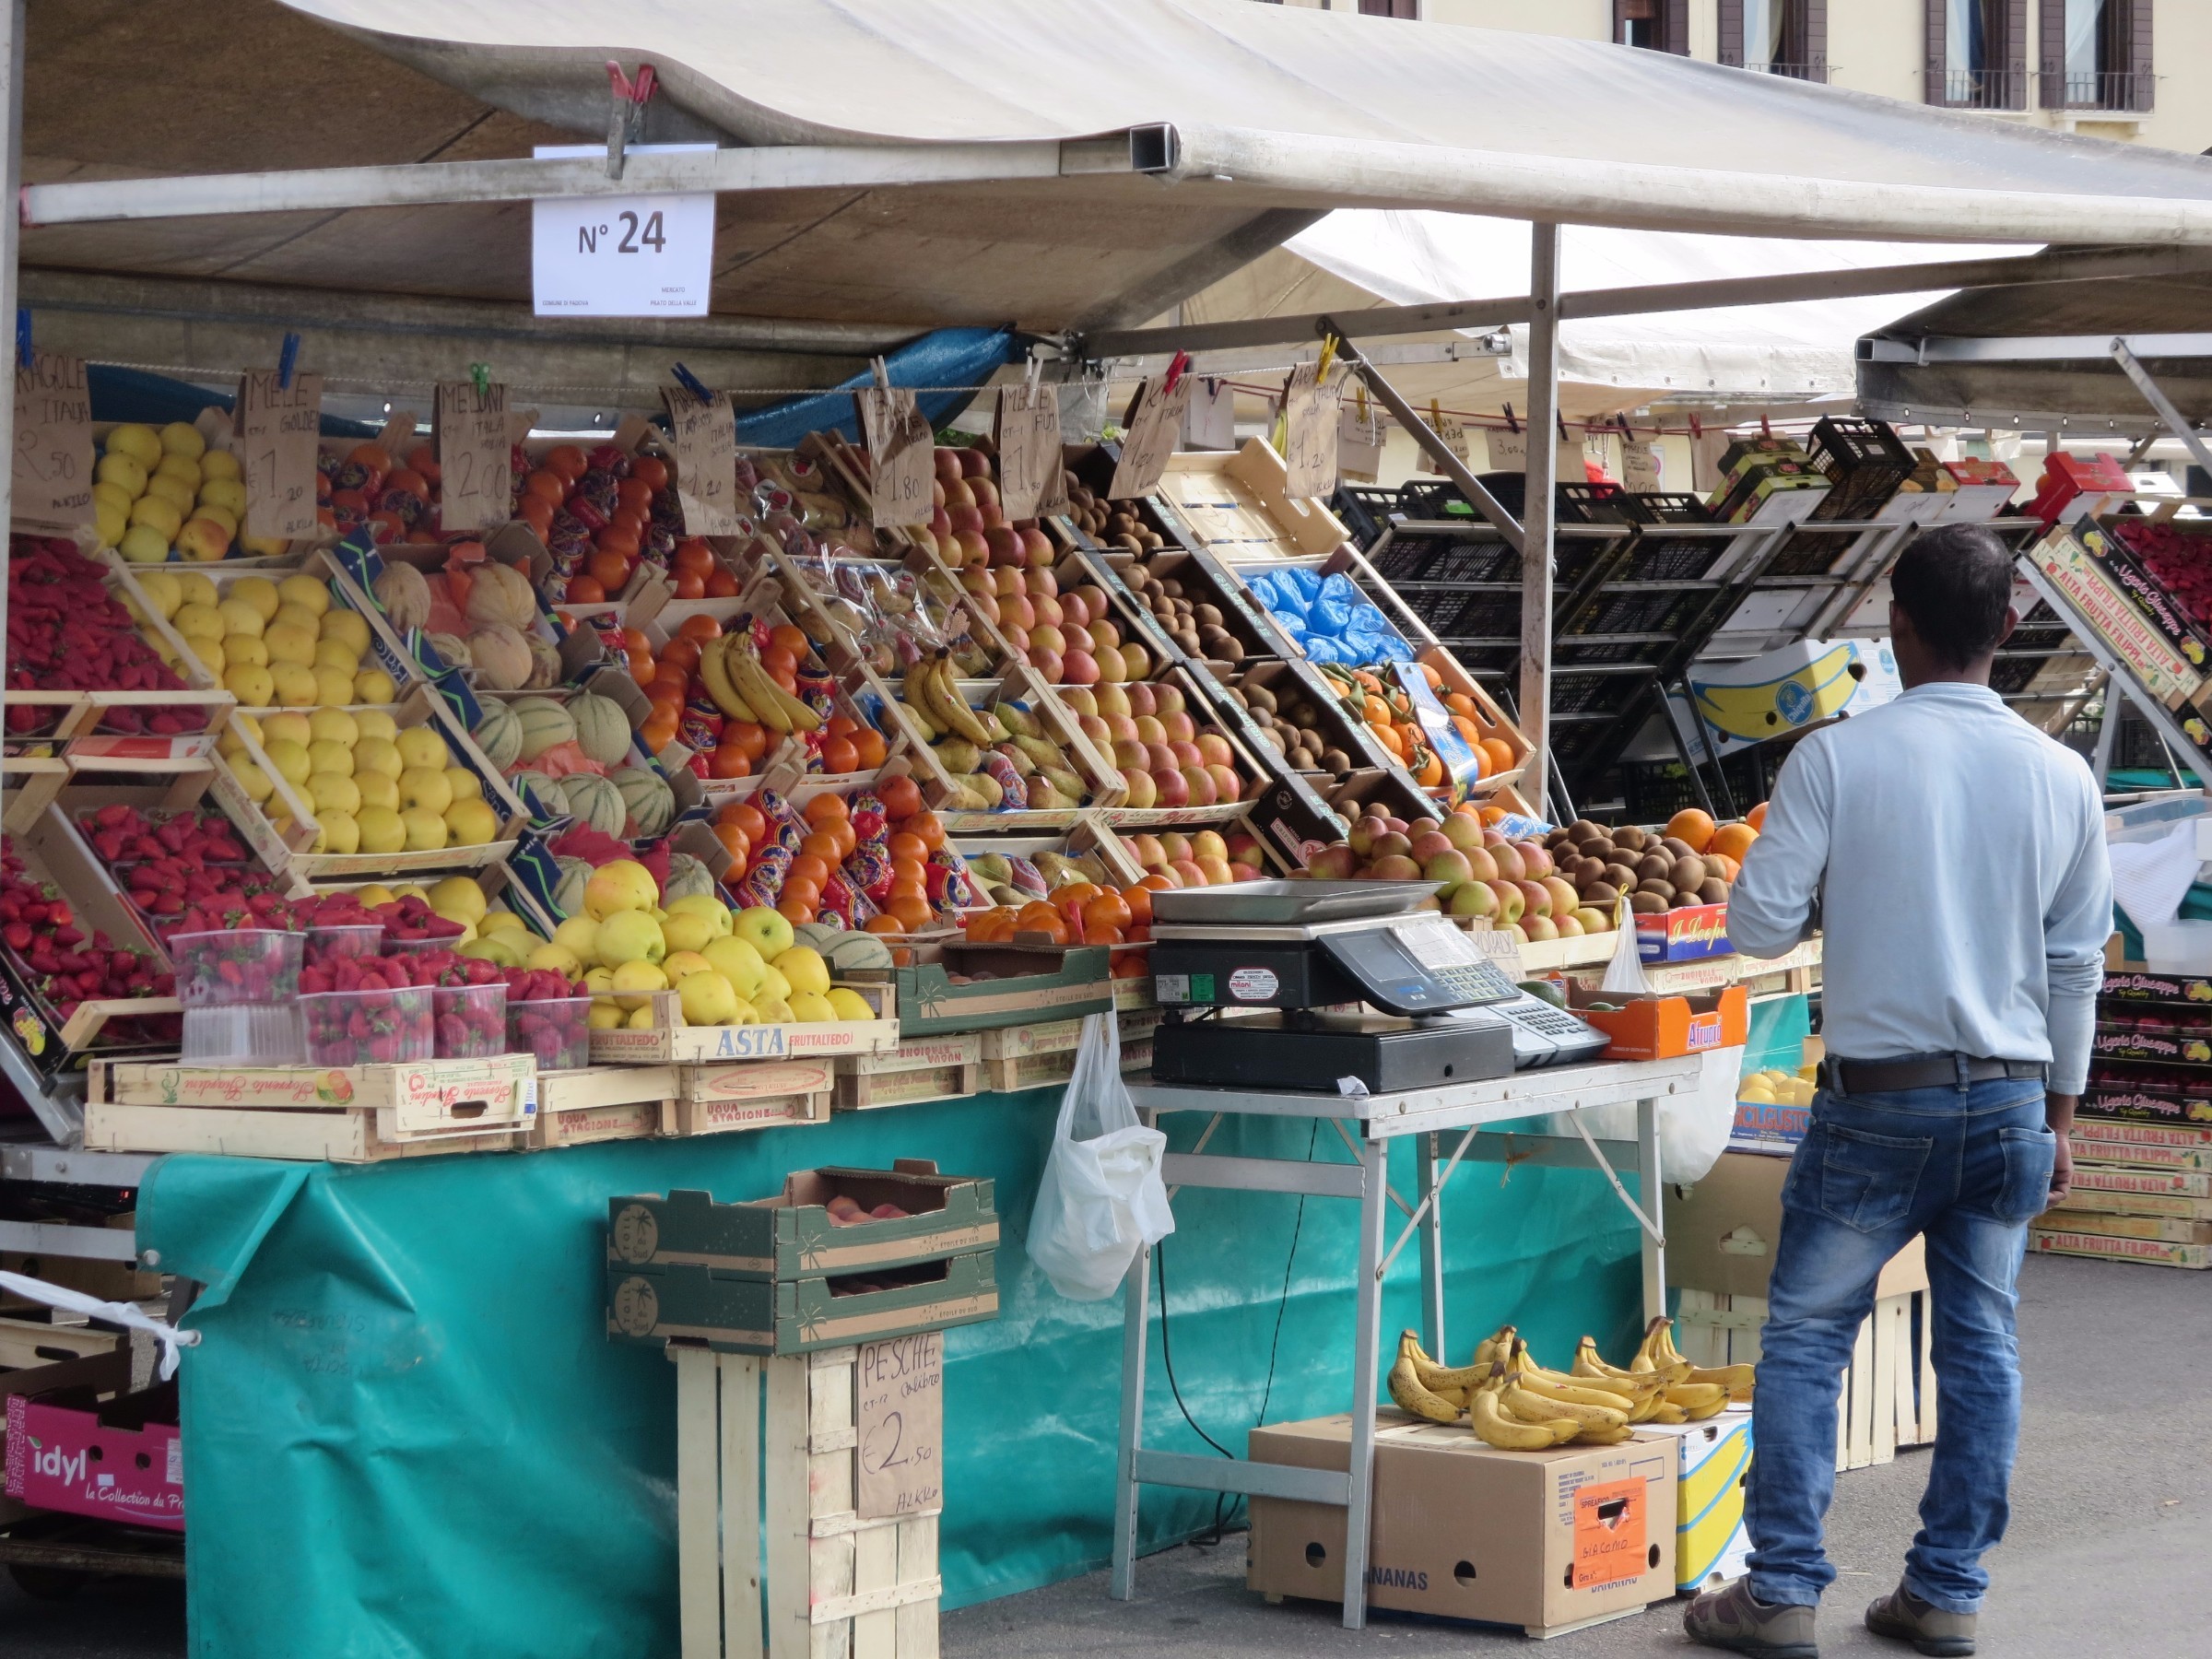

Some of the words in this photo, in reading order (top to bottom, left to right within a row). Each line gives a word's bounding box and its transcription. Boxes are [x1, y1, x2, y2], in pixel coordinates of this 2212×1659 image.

[579, 224, 608, 253] N°
[618, 210, 666, 253] 24
[1035, 413, 1058, 432] FUJI
[1215, 571, 1273, 639] GRIFONE
[2087, 573, 2119, 610] FILIPPI
[2059, 571, 2081, 599] ALTA
[2078, 593, 2112, 635] FRUTTA
[2110, 625, 2143, 663] FILIPPI
[2114, 604, 2148, 643] FRUTTA
[2146, 639, 2171, 665] ALTA
[1787, 694, 1813, 724] Chiquita
[716, 1028, 784, 1057] ASTA
[789, 1030, 853, 1047] FRUTTALTEDO
[1688, 1019, 1723, 1049] Afrupro
[183, 1077, 241, 1101] Giardini
[249, 1078, 316, 1102] Sorrento
[464, 1085, 512, 1103] Sorrento
[2083, 1124, 2121, 1141] FILIPPI
[2123, 1126, 2164, 1145] FRUTTA
[2166, 1129, 2194, 1146] ALTA
[2089, 1144, 2131, 1160] FRUTTA
[2133, 1147, 2171, 1163] FILIPPI
[2096, 1172, 2137, 1191] FRUTTA
[2140, 1175, 2167, 1192] ALTA
[633, 1246, 648, 1259] Sud
[2055, 1232, 2080, 1249] ALTA
[2083, 1236, 2123, 1253] FRUTTA
[2124, 1240, 2161, 1256] FILIPPI
[633, 1320, 649, 1332] Sud
[865, 1333, 940, 1388] PESCHE
[34, 1444, 87, 1487] idyl
[85, 1482, 95, 1500] la
[99, 1487, 150, 1505] Collection
[153, 1492, 164, 1508] du
[168, 1493, 184, 1510] Pr
